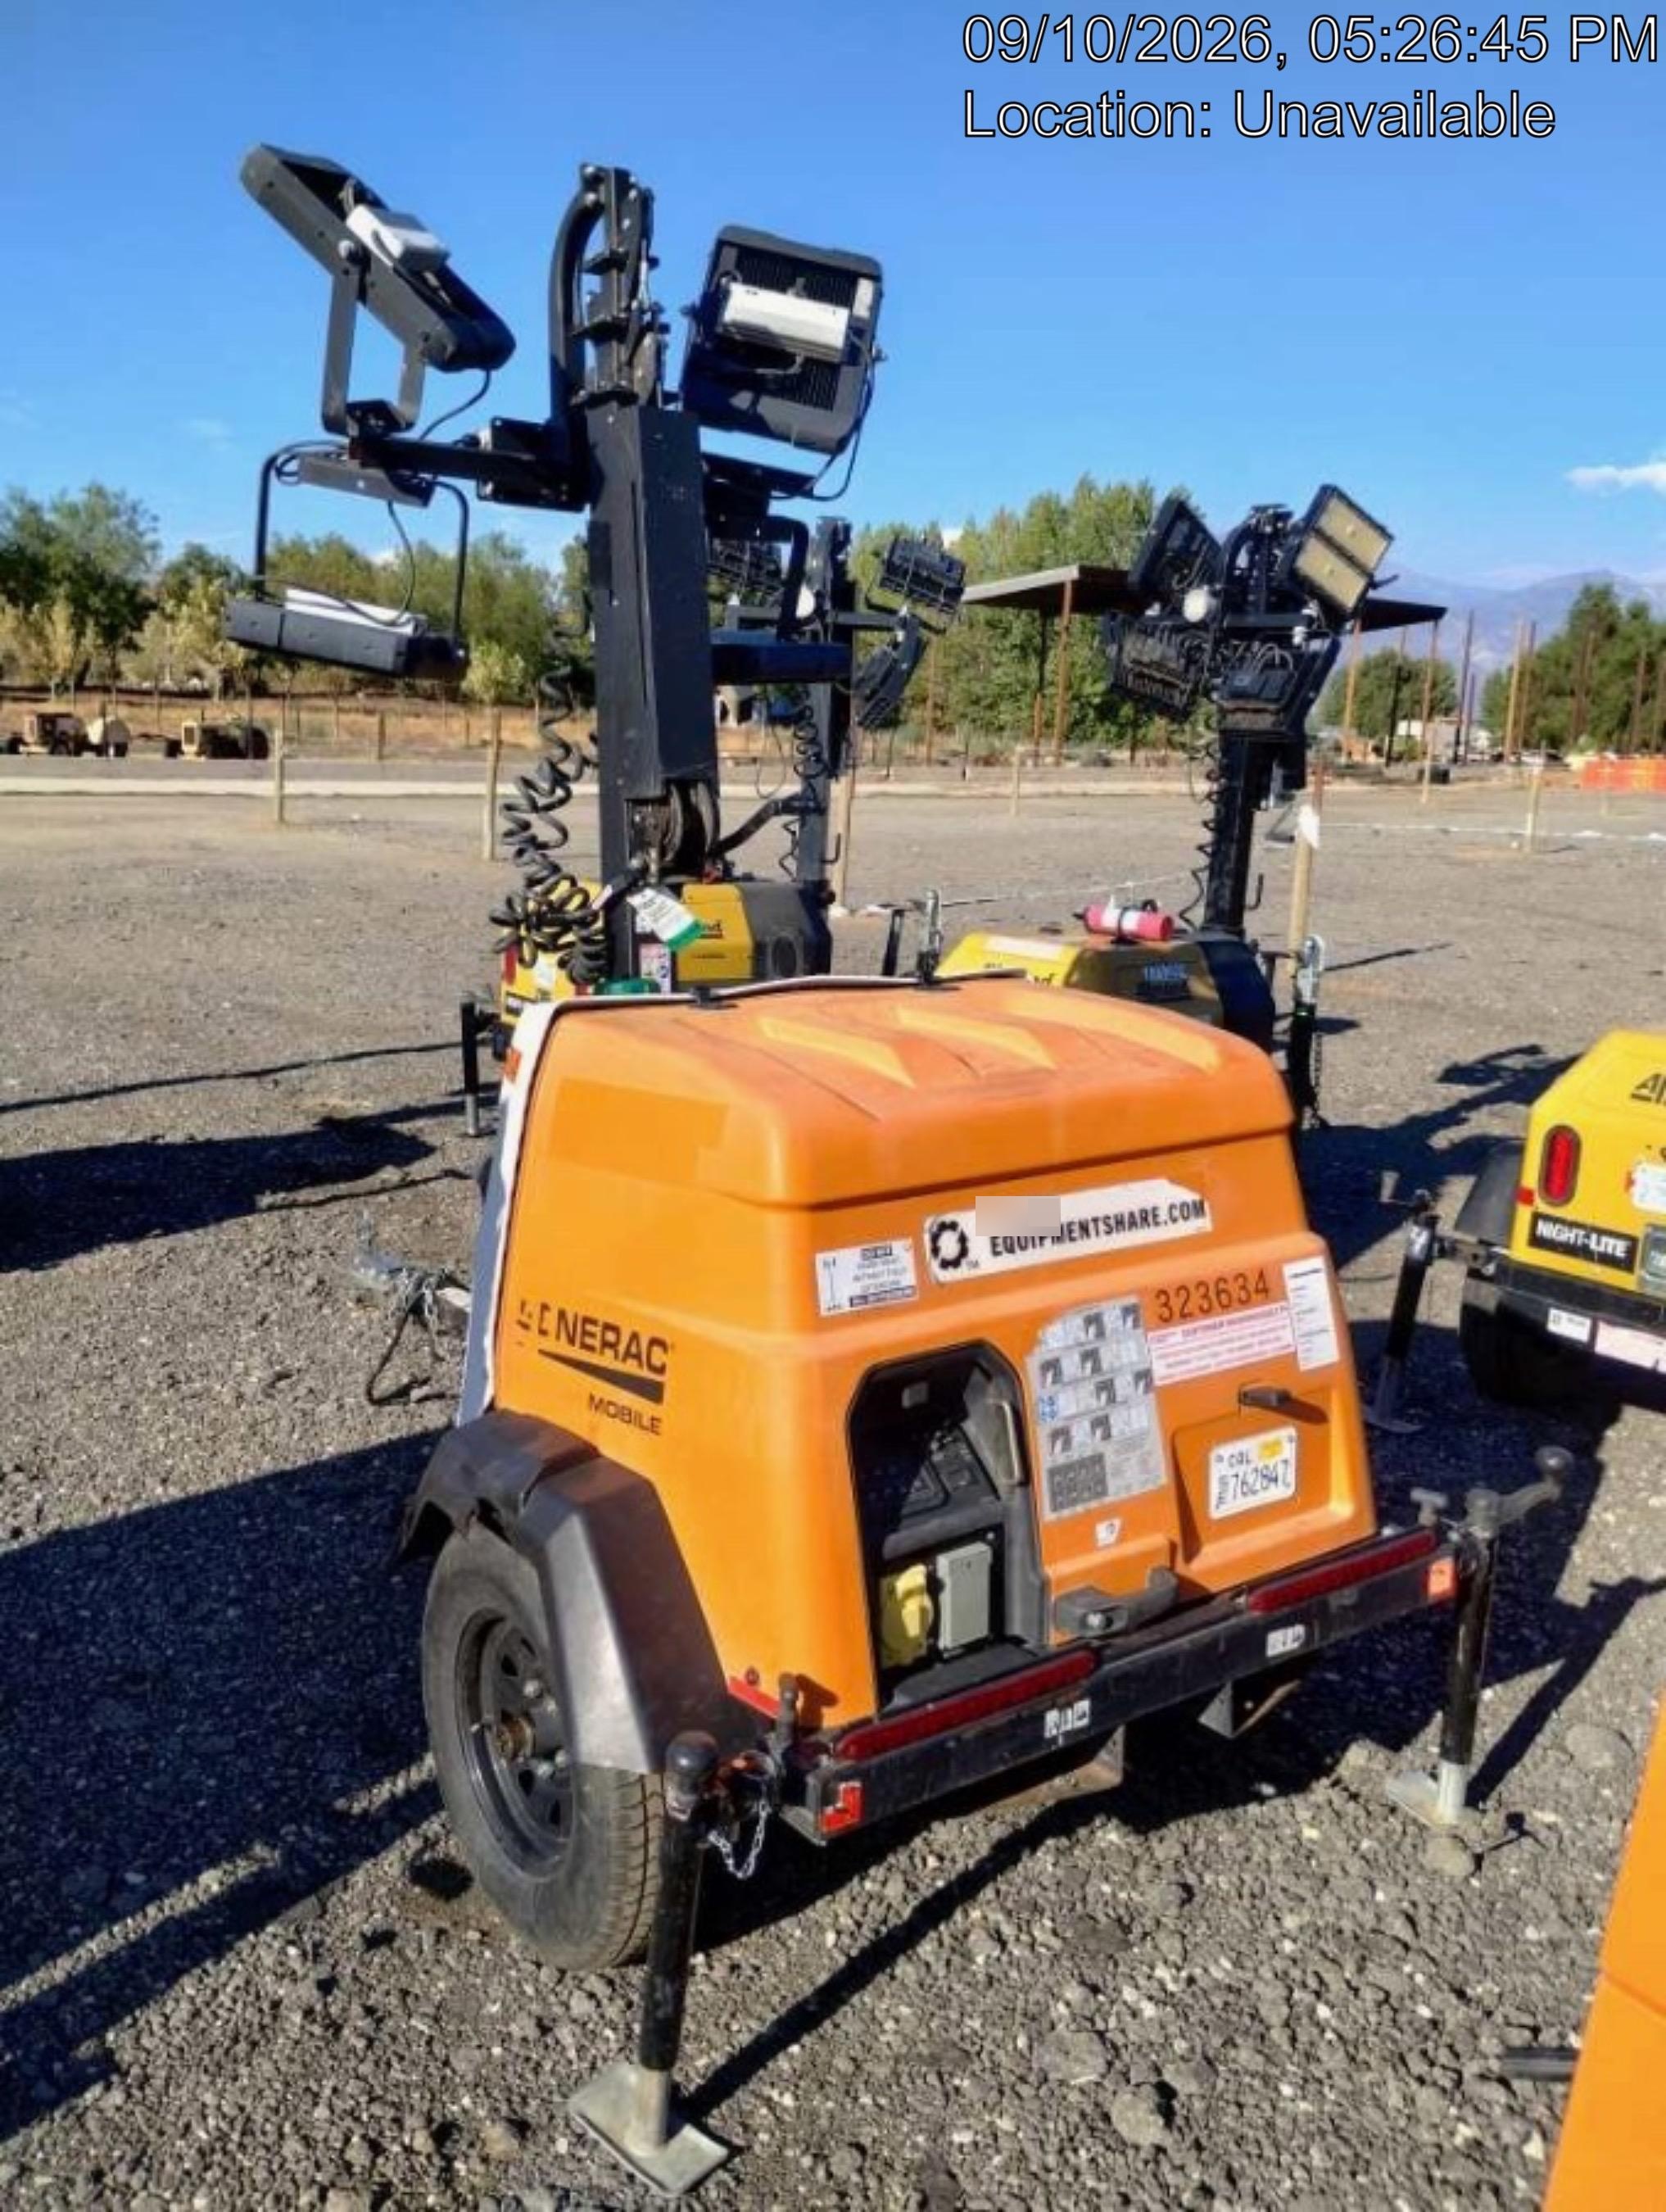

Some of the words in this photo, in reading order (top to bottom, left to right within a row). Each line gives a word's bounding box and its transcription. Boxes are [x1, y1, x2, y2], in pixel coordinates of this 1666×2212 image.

[1536, 1218, 1632, 1258] NIGHT-LITE
[1155, 1267, 1269, 1323] 323634
[588, 1393, 662, 1435] MOBILE
